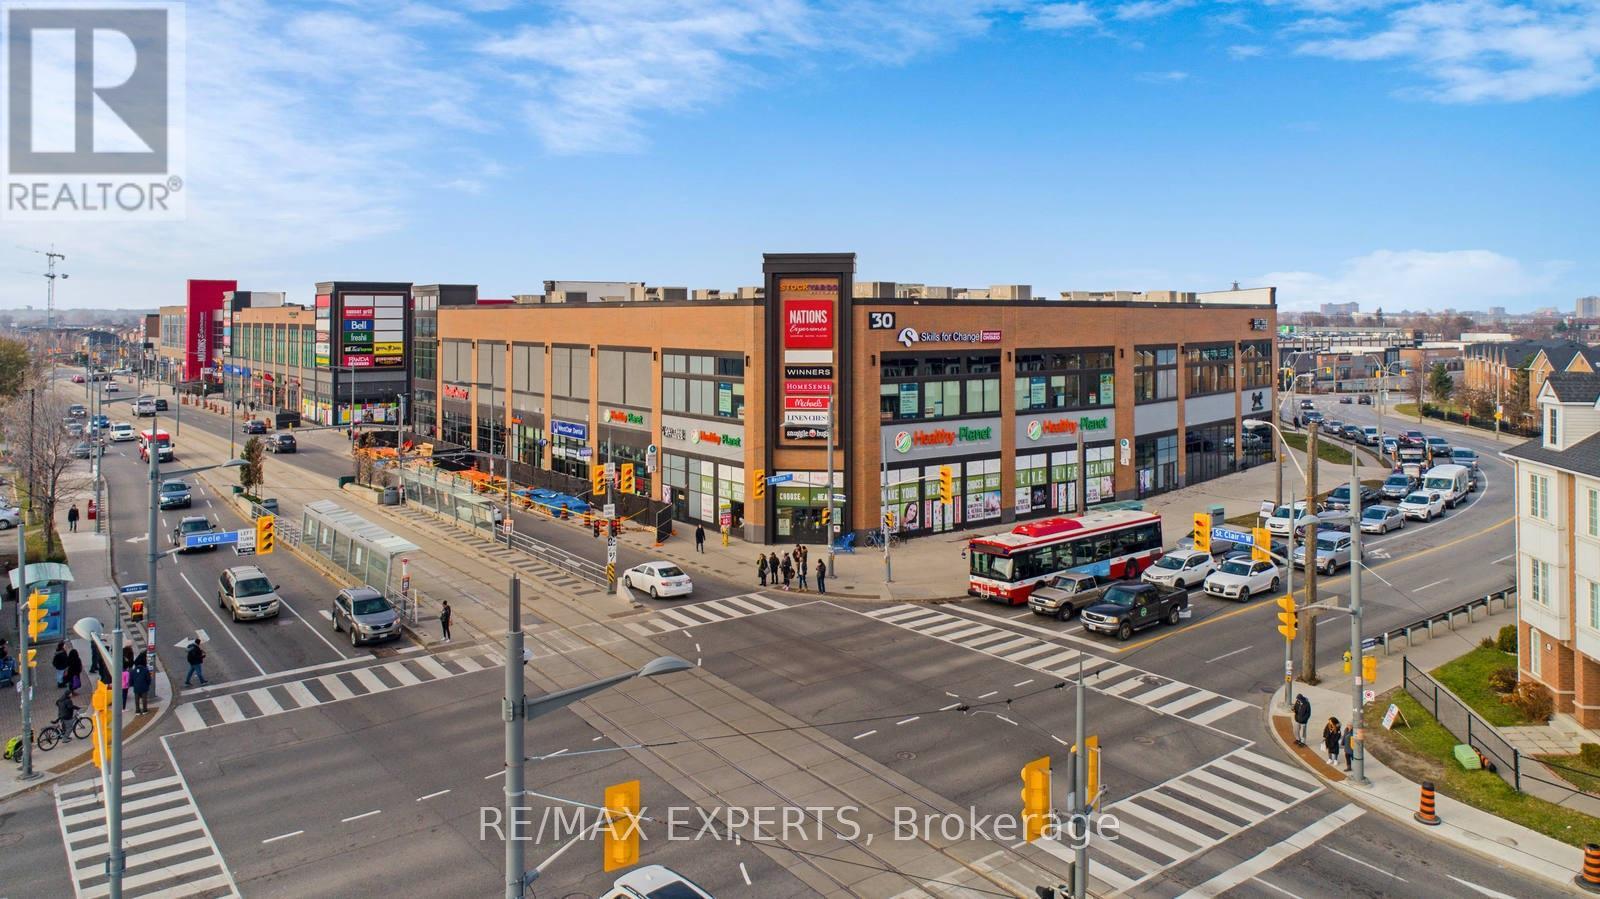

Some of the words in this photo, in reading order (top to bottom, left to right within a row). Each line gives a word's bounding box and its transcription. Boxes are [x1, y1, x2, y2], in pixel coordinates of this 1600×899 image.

[790, 309, 828, 324] NATIONS
[871, 313, 893, 328] 30
[351, 321, 367, 329] Bell
[921, 332, 940, 341] Skills
[941, 332, 952, 341] for
[953, 332, 980, 343] Change
[787, 368, 831, 376] WINNERS
[795, 399, 823, 407] Michaels
[1043, 418, 1078, 435] Healthy
[1080, 416, 1107, 430] Planet
[722, 433, 741, 447] Planet
[913, 429, 955, 447] Healthy
[959, 426, 992, 441] Planet
[1020, 470, 1043, 484] LIVE
[1056, 466, 1078, 480] LIFE
[779, 492, 801, 501] CHOOSE
[197, 534, 221, 544] Keele
[1215, 529, 1223, 537] St
[1224, 531, 1240, 540] Clair
